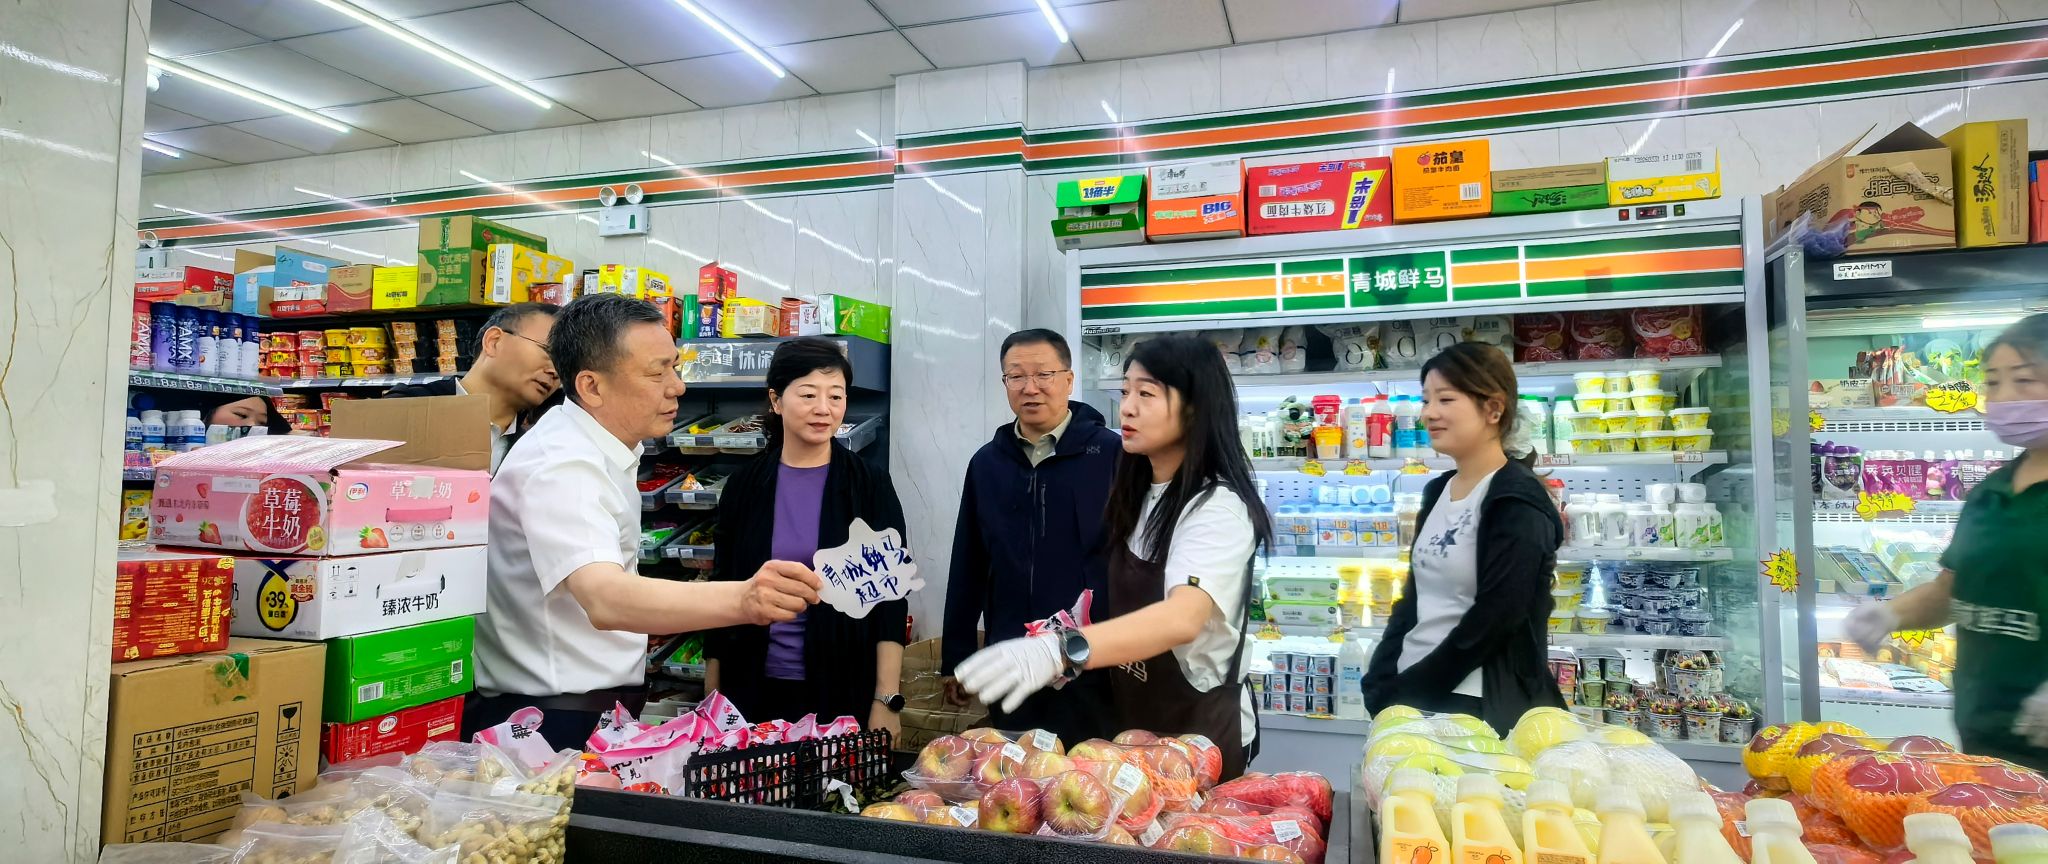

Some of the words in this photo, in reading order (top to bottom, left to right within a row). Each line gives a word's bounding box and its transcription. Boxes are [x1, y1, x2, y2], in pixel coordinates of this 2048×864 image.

[1433, 151, 1464, 165] 茄皇
[1202, 201, 1232, 215] BIG
[1267, 202, 1327, 218] 红烧牛肉面
[1838, 262, 1887, 272] GRAMMY
[1351, 267, 1445, 293] 青城鲜马
[1840, 379, 1869, 388] 奶皮子
[391, 480, 453, 500] 草奶
[262, 487, 303, 514] 草莓
[261, 513, 303, 540] 牛奶
[855, 574, 899, 608] 超市
[382, 593, 439, 616] 臻浓牛奶
